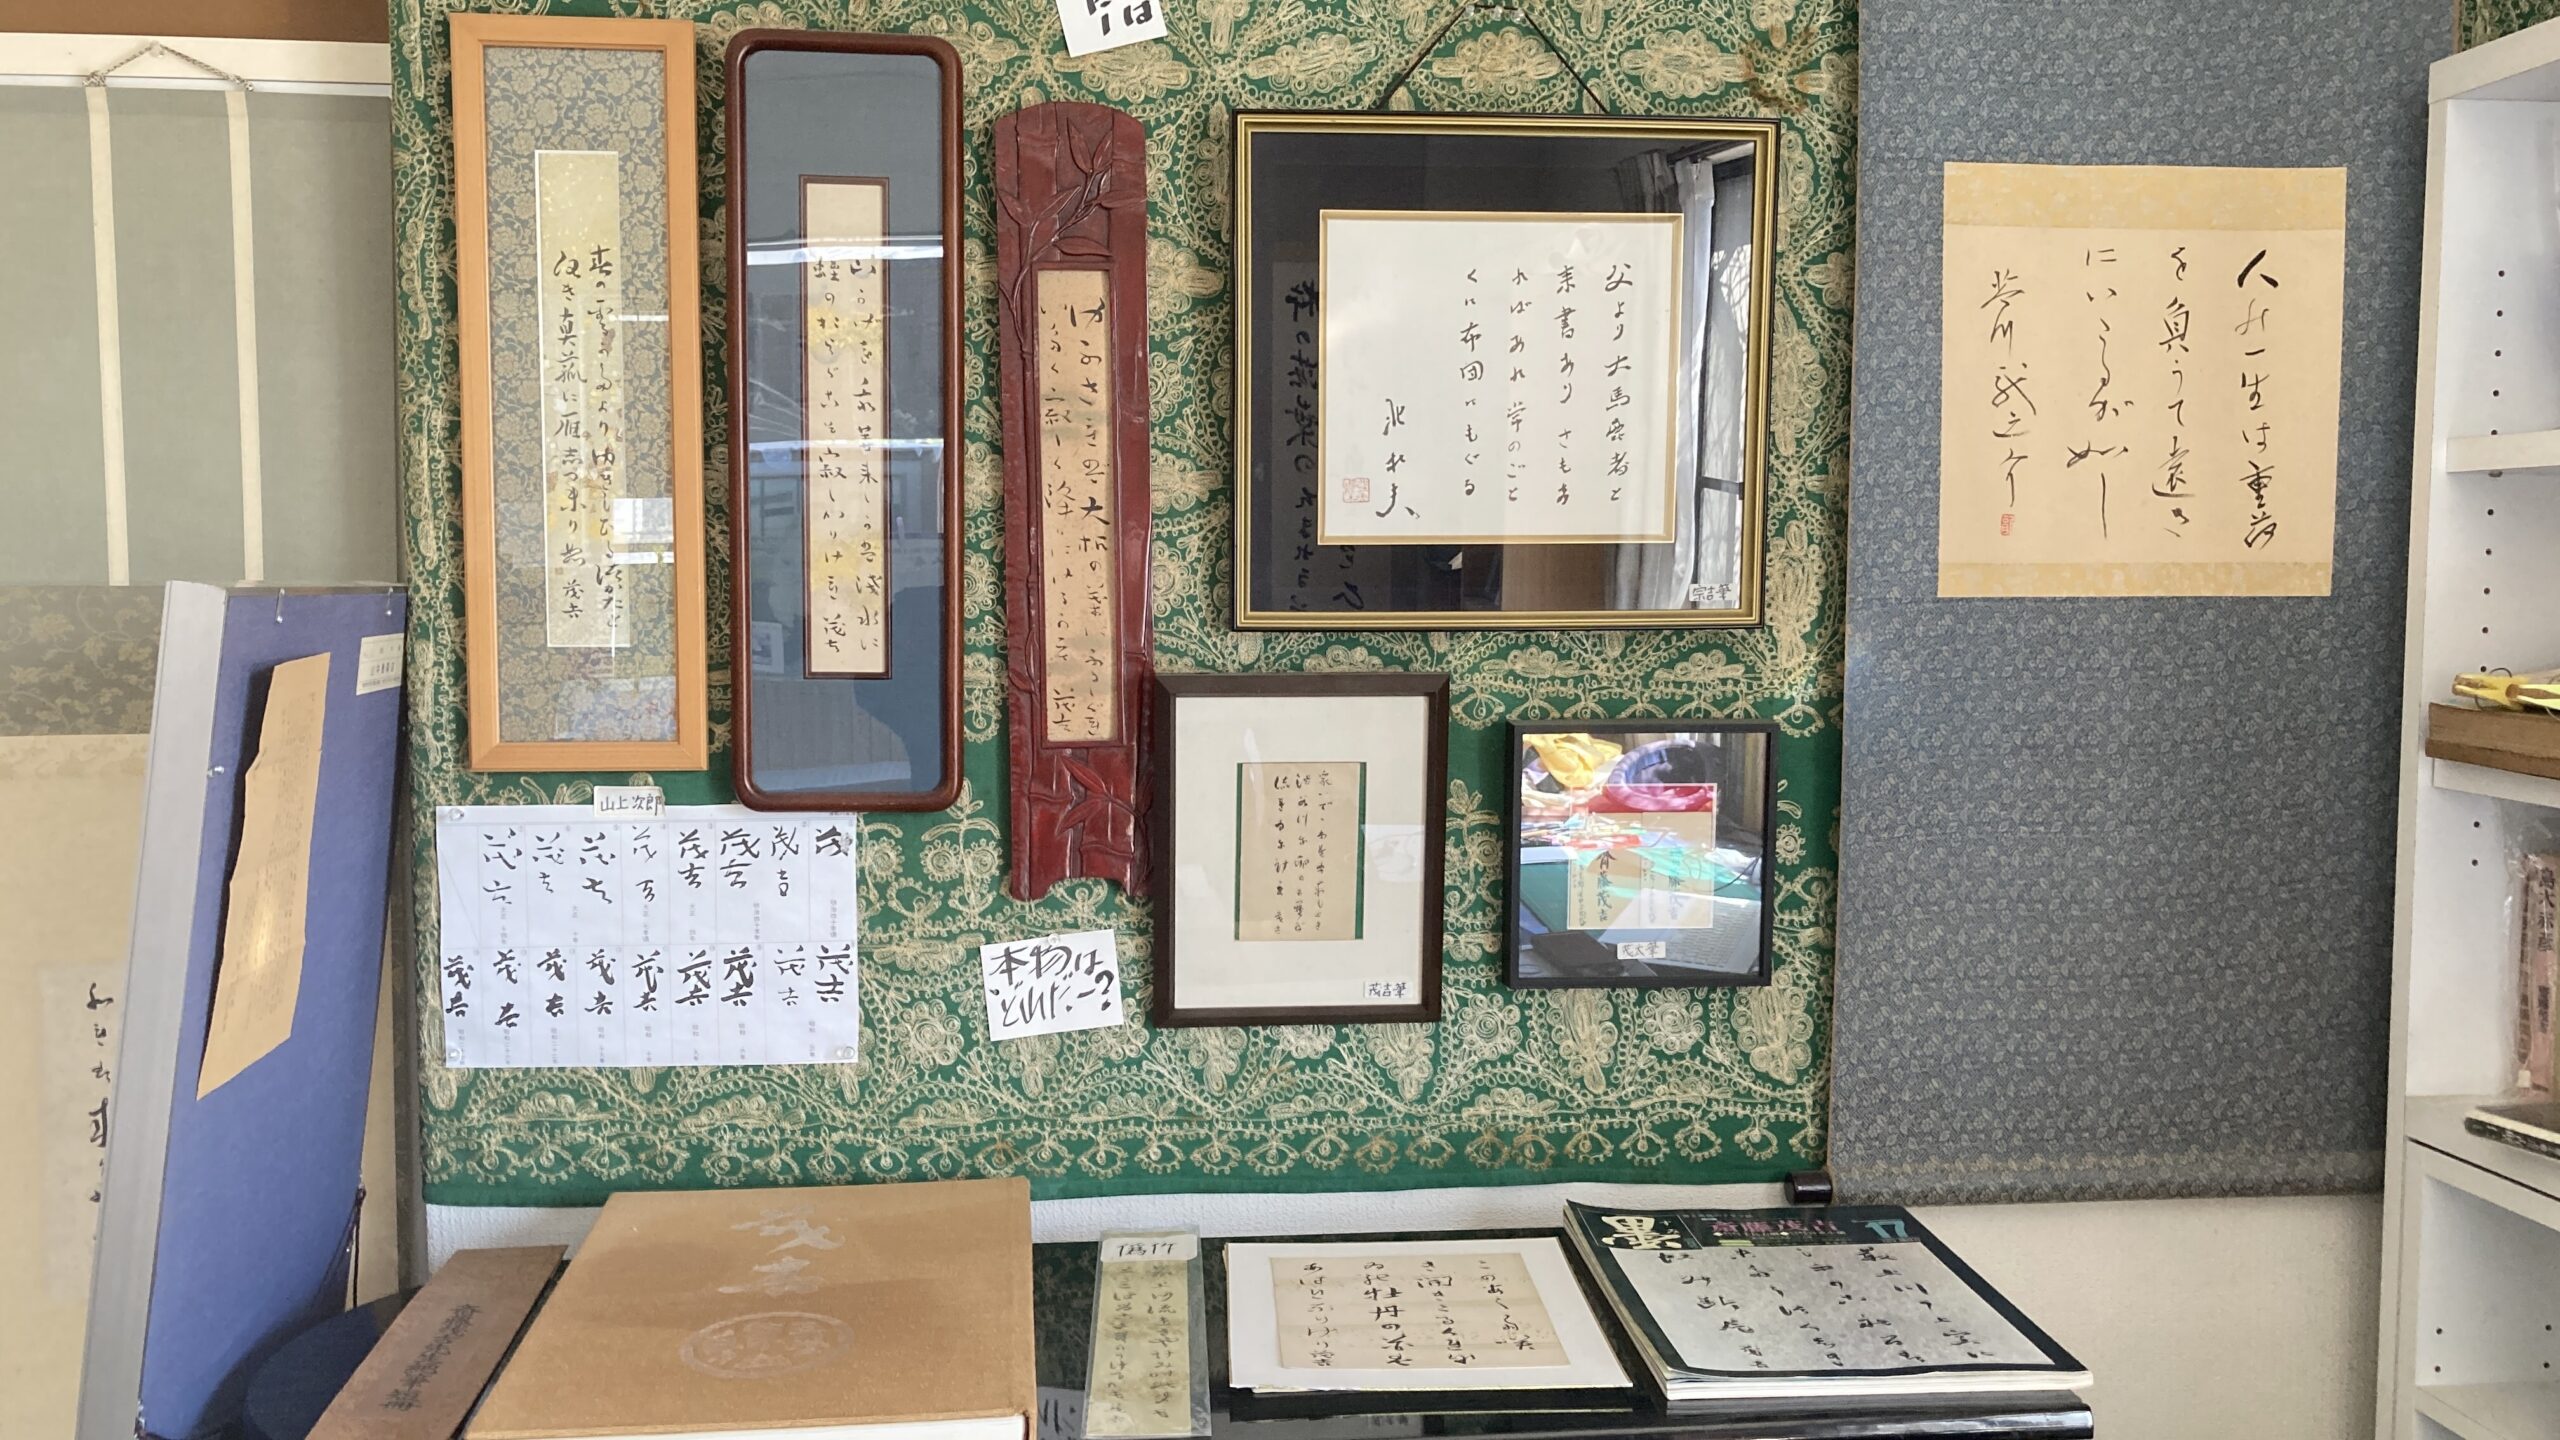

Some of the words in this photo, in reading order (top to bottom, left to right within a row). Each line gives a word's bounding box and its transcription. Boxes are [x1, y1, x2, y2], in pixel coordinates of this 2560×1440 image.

[600, 793, 663, 816] 山上次郎
[989, 945, 1104, 986] 本物は
